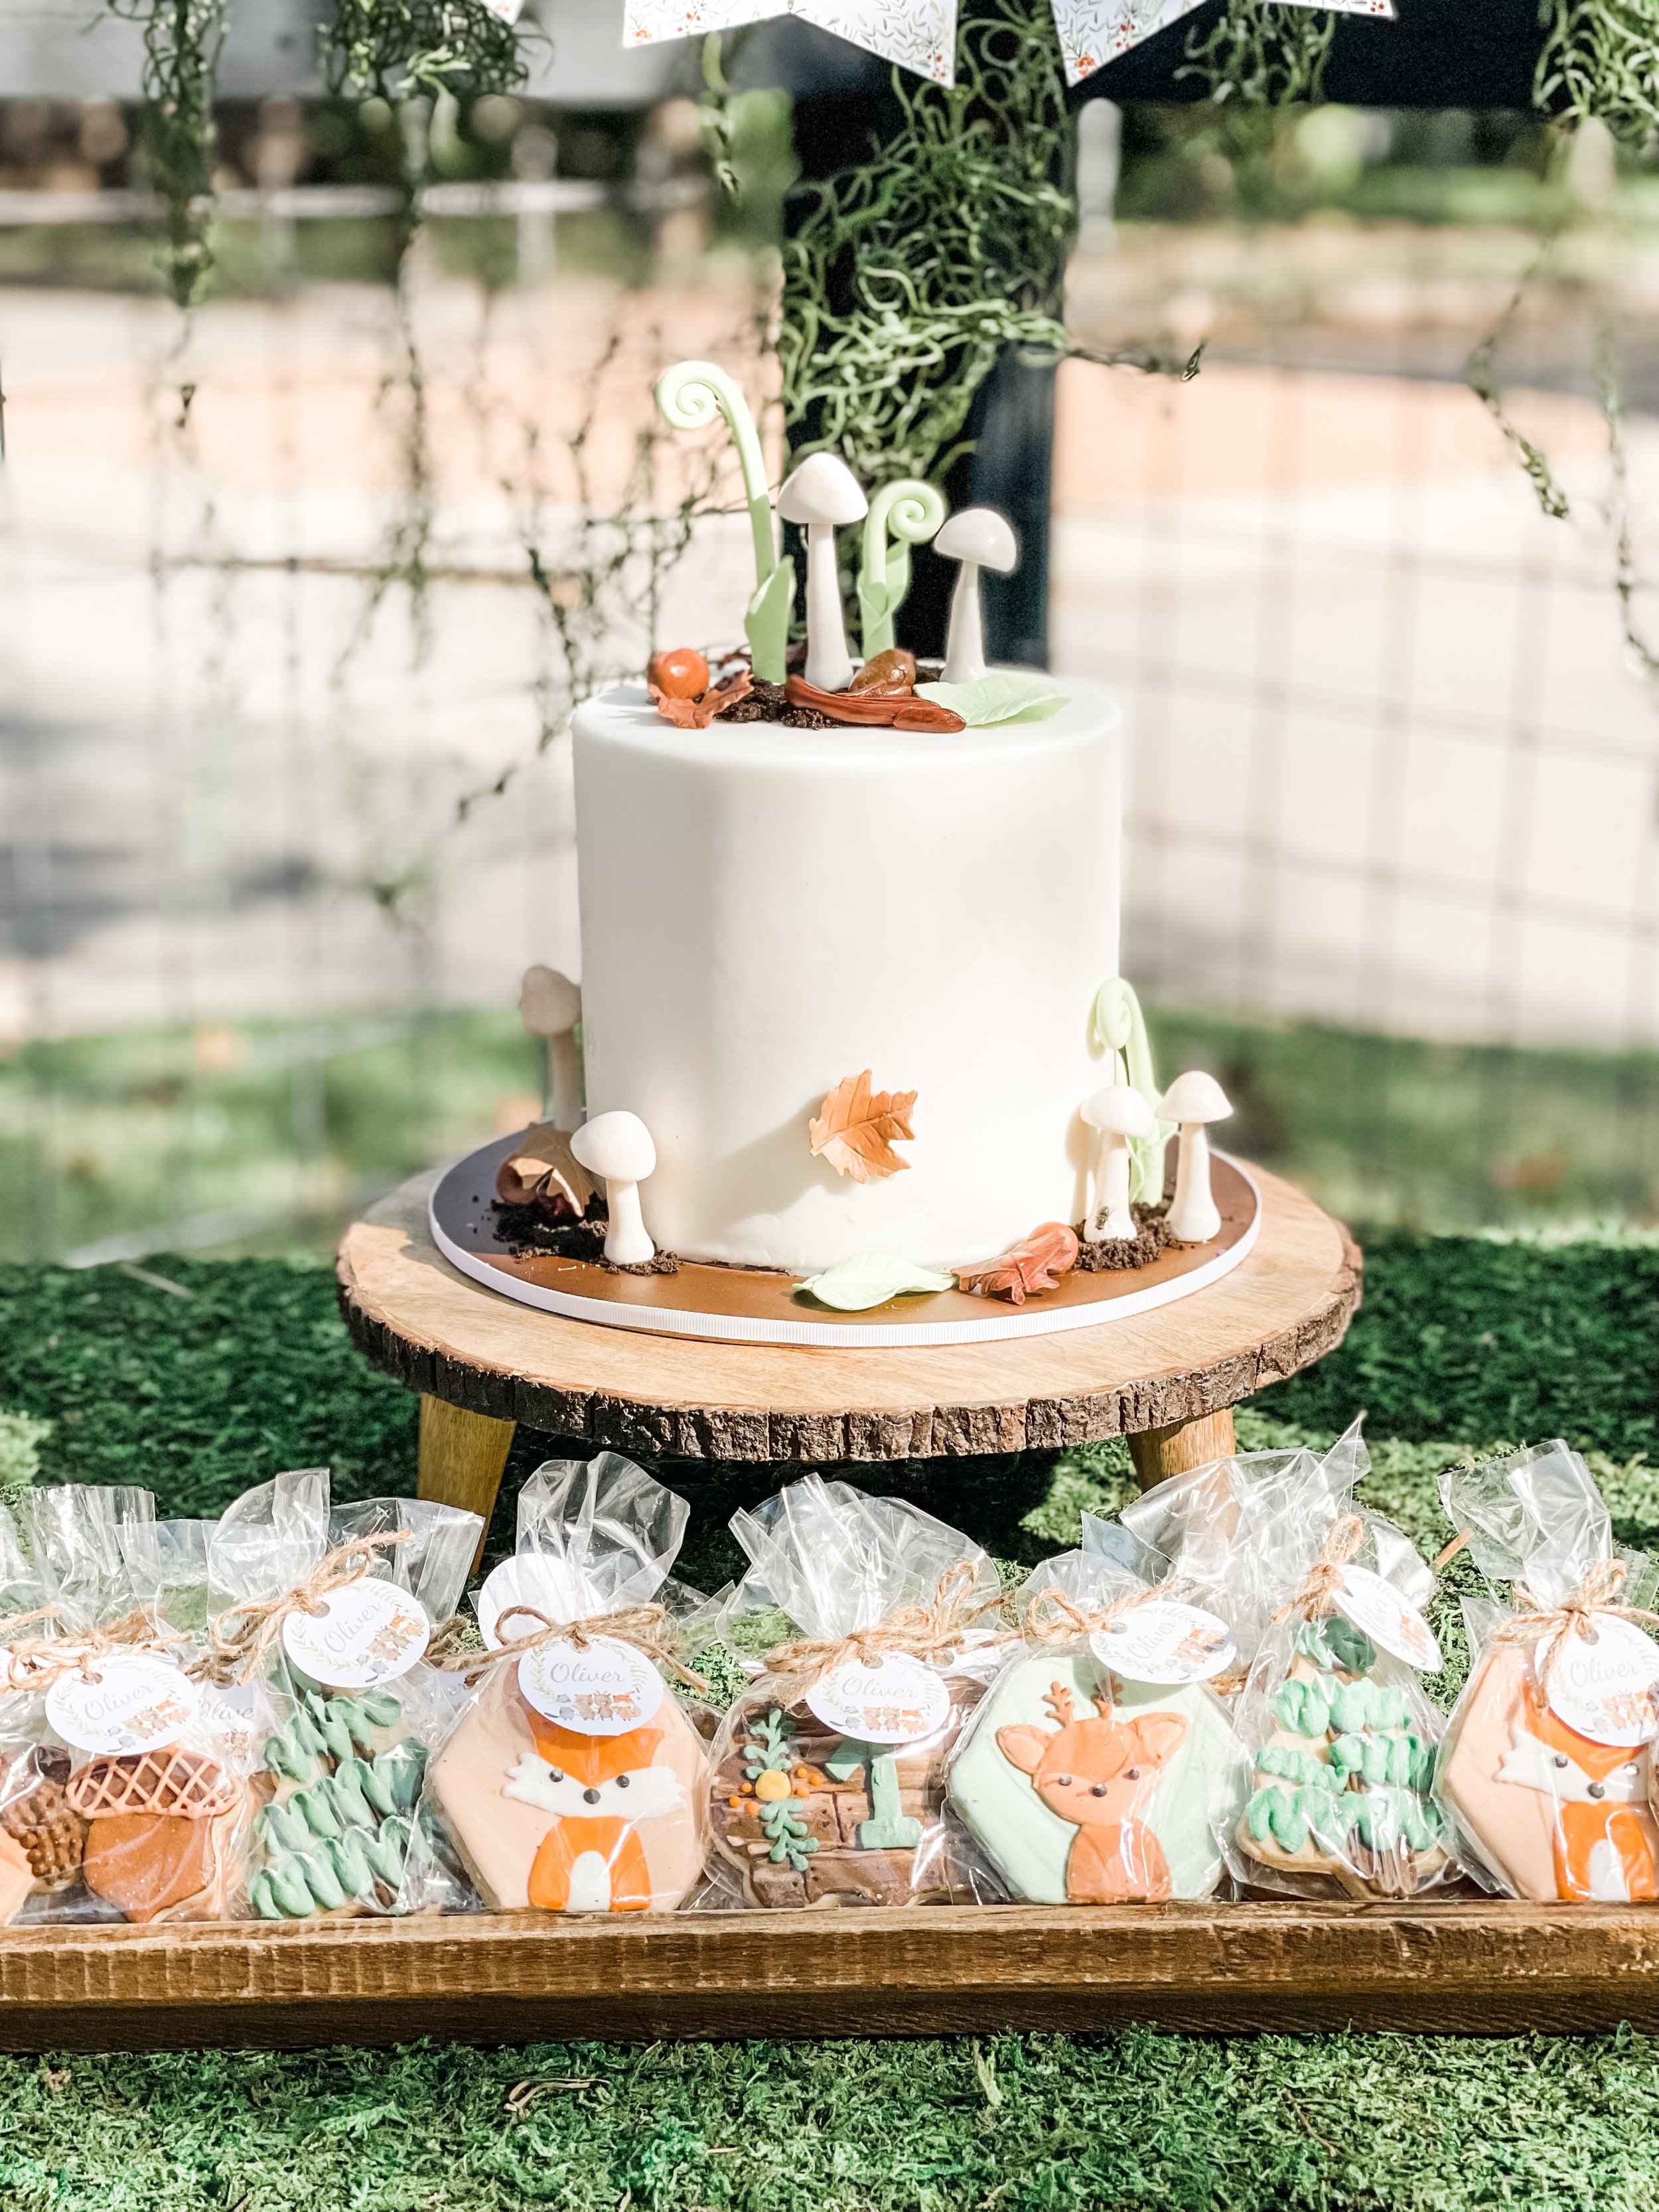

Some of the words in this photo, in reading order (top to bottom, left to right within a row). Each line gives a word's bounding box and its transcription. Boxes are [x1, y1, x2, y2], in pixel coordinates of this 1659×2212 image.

[324, 1601, 381, 1653] Oliver
[1127, 1621, 1177, 1659] Oliver
[549, 1662, 626, 1683] Oliver
[841, 1676, 919, 1699] Oliver
[1569, 1657, 1640, 1687] Oliver
[84, 1683, 155, 1720] Oliver
